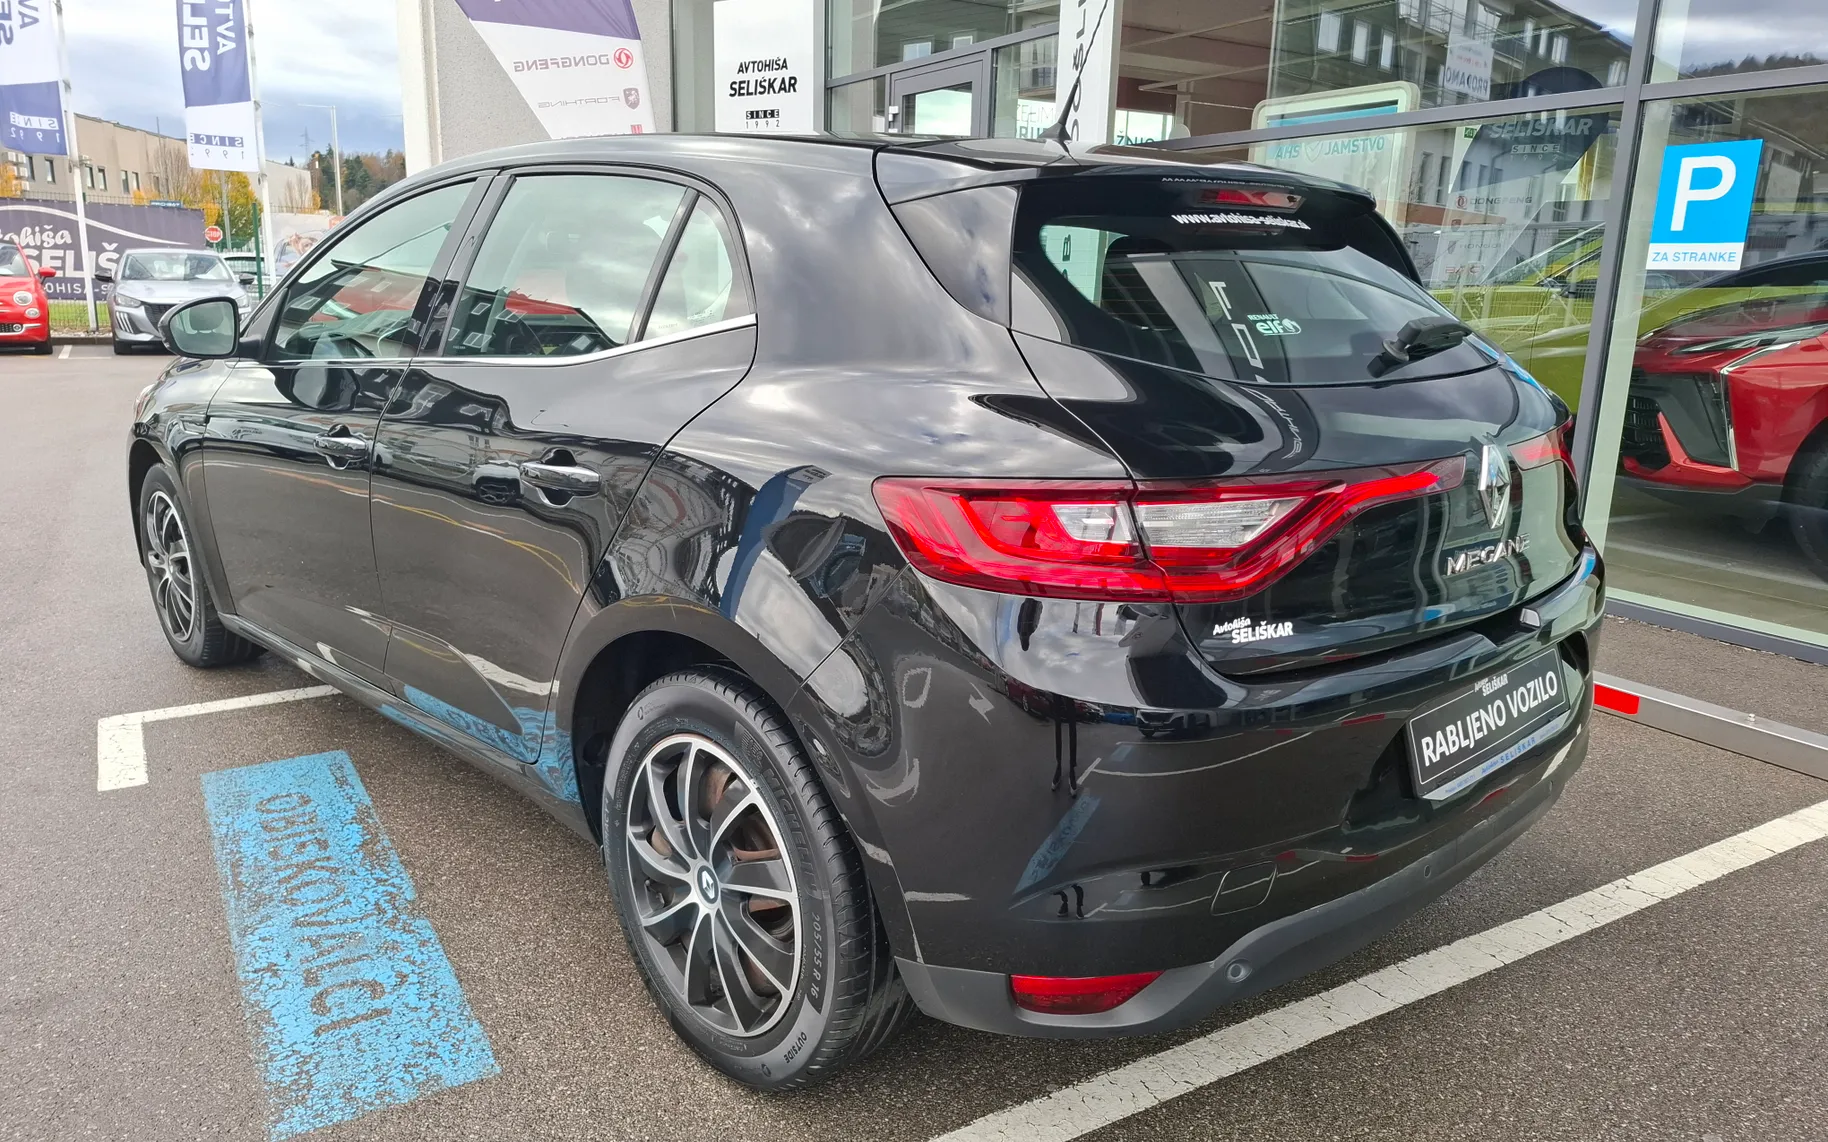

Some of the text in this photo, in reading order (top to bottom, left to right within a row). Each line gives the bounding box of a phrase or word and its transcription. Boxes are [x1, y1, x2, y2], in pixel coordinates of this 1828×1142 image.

[737, 56, 788, 74] AVTOHIŠA
[729, 76, 798, 97] SELIŠKAR
[746, 109, 780, 119] SINCE
[746, 120, 780, 129] 1992
[1275, 136, 1385, 160] AHS JAMSTVO
[1670, 155, 1737, 231] P
[1652, 251, 1737, 262] ZA STRANKE
[1247, 313, 1280, 321] RENAULT
[1256, 320, 1285, 334] elf
[1447, 533, 1531, 576] MEGANE
[1231, 620, 1294, 644] SELIŠKAR
[1421, 670, 1558, 767] RABLJENO VOZILO
[811, 911, 823, 999] 205/55 R 16
[783, 1031, 808, 1064] OUTSIDE
